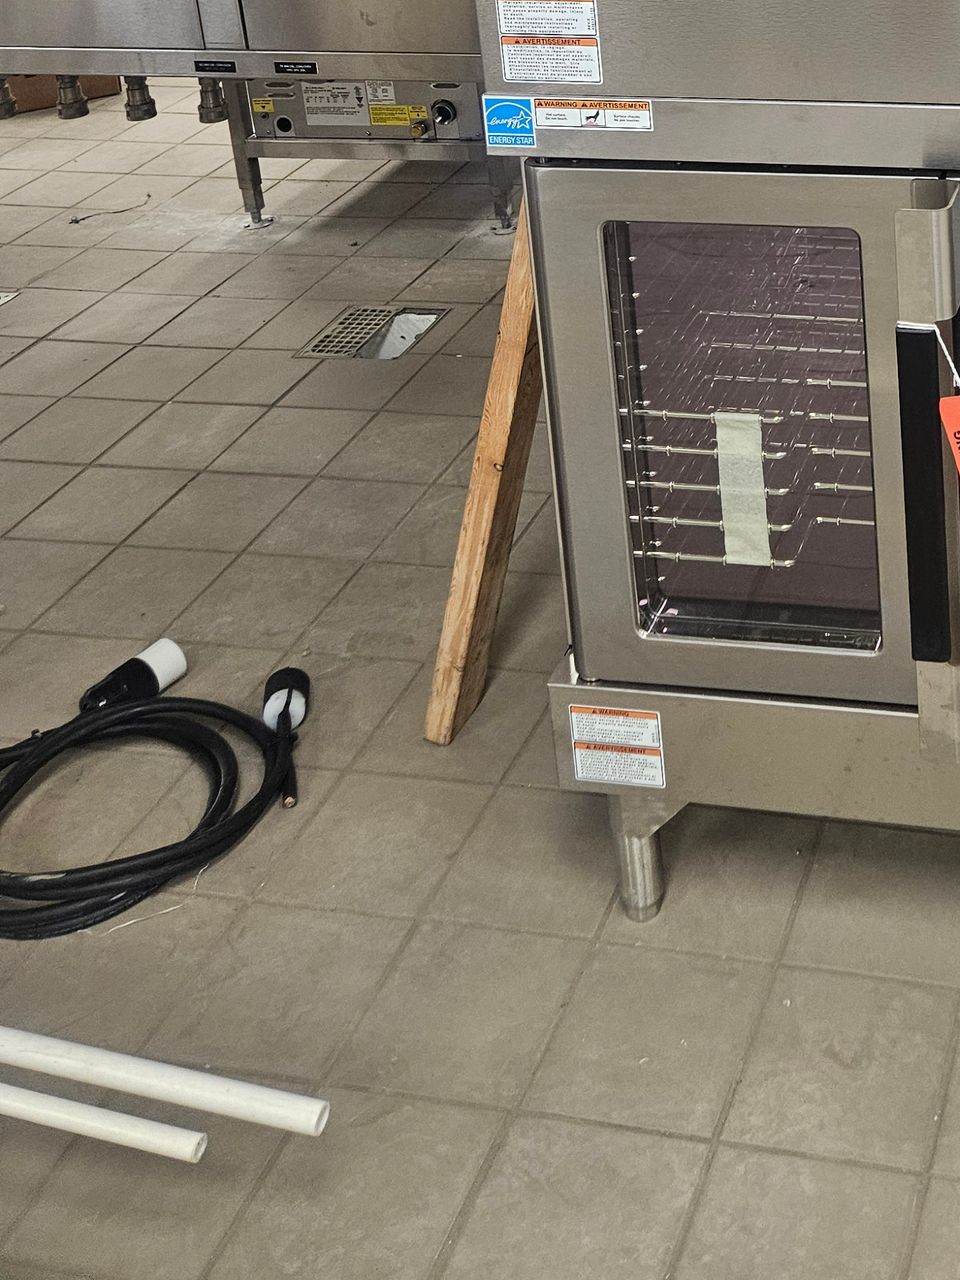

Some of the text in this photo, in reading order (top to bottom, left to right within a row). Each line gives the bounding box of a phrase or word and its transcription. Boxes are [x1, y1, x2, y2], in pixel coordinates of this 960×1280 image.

[589, 102, 648, 110] AVERTISSEMENT
[489, 136, 533, 145] ENERGY STAR
[600, 709, 629, 717] WARNING
[594, 745, 646, 754] AVERTISSEMENT
